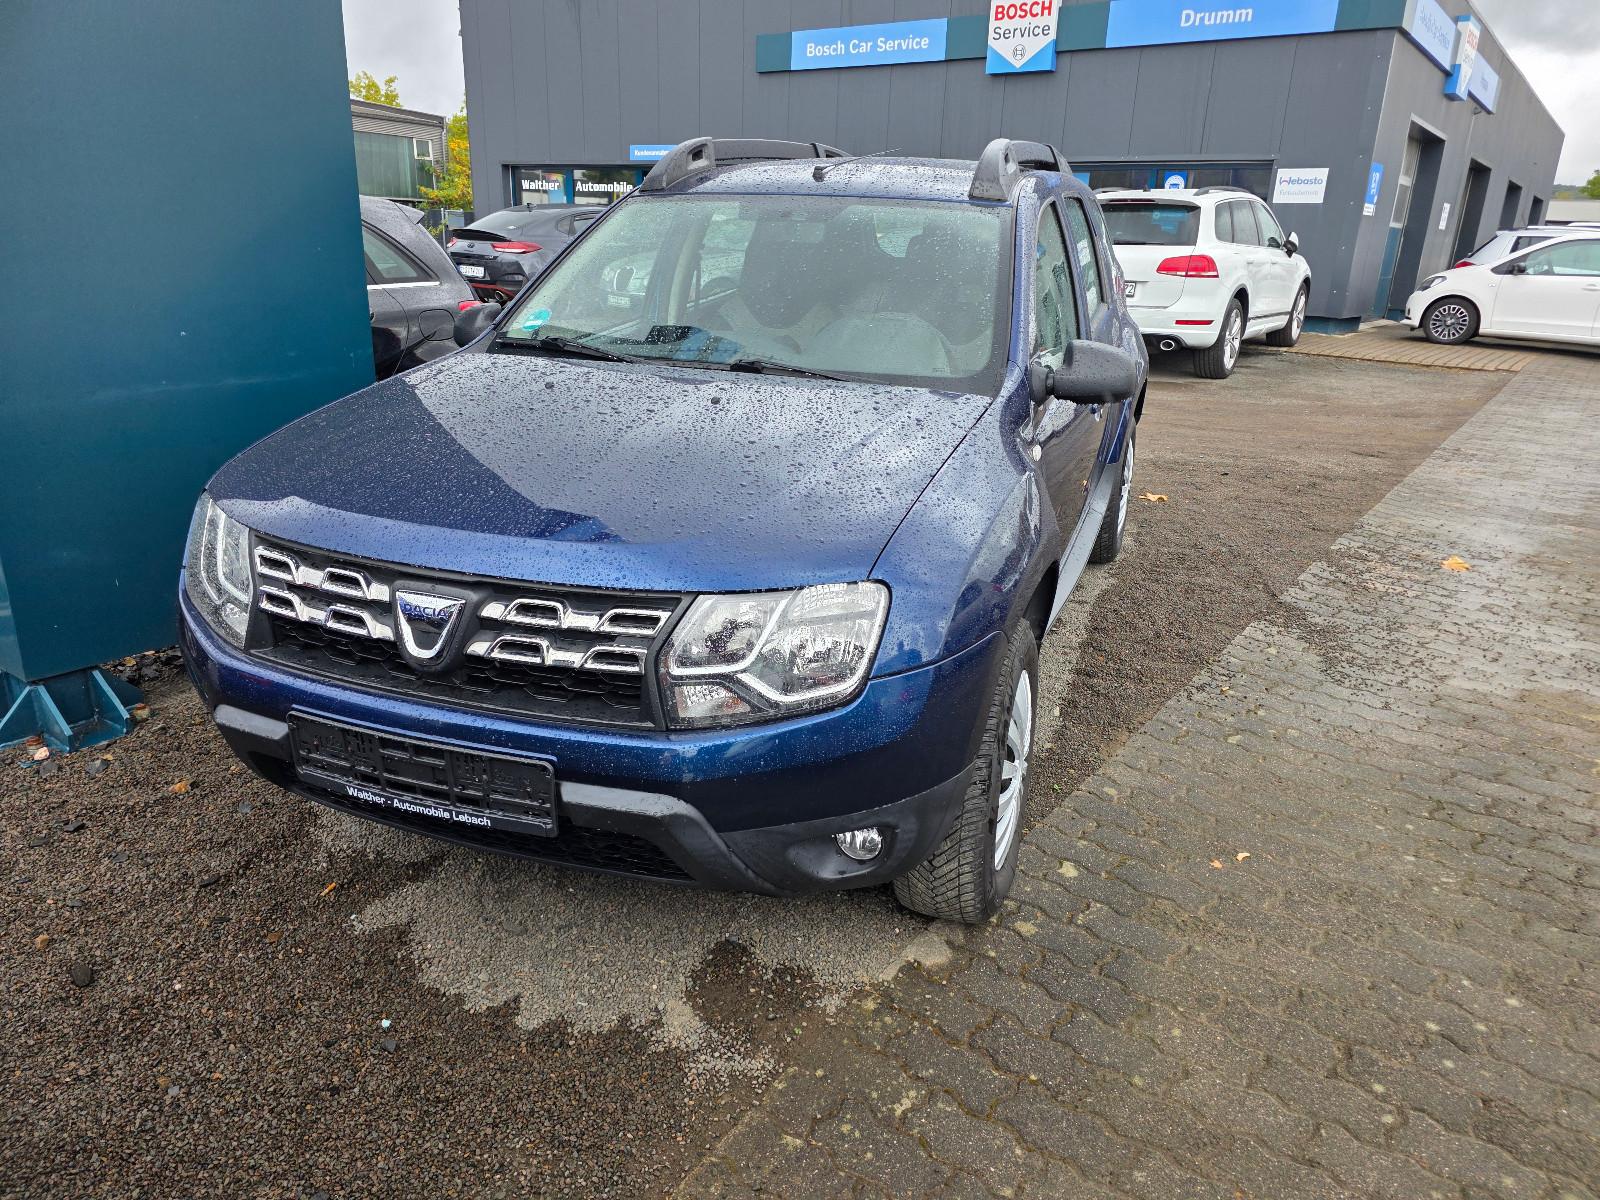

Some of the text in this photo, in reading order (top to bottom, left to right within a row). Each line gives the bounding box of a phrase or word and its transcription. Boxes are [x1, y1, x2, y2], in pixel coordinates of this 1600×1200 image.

[994, 0, 1053, 21] BOSCH
[1180, 8, 1253, 27] Drumm
[992, 22, 1051, 41] Service
[806, 34, 929, 57] Bosch Car Service
[521, 179, 634, 192] Walther Automobile
[1279, 176, 1324, 186] Webasto
[404, 603, 449, 619] DACIA
[346, 786, 386, 805] Walther
[393, 798, 451, 819] Automobile
[452, 810, 491, 827] Lebach
